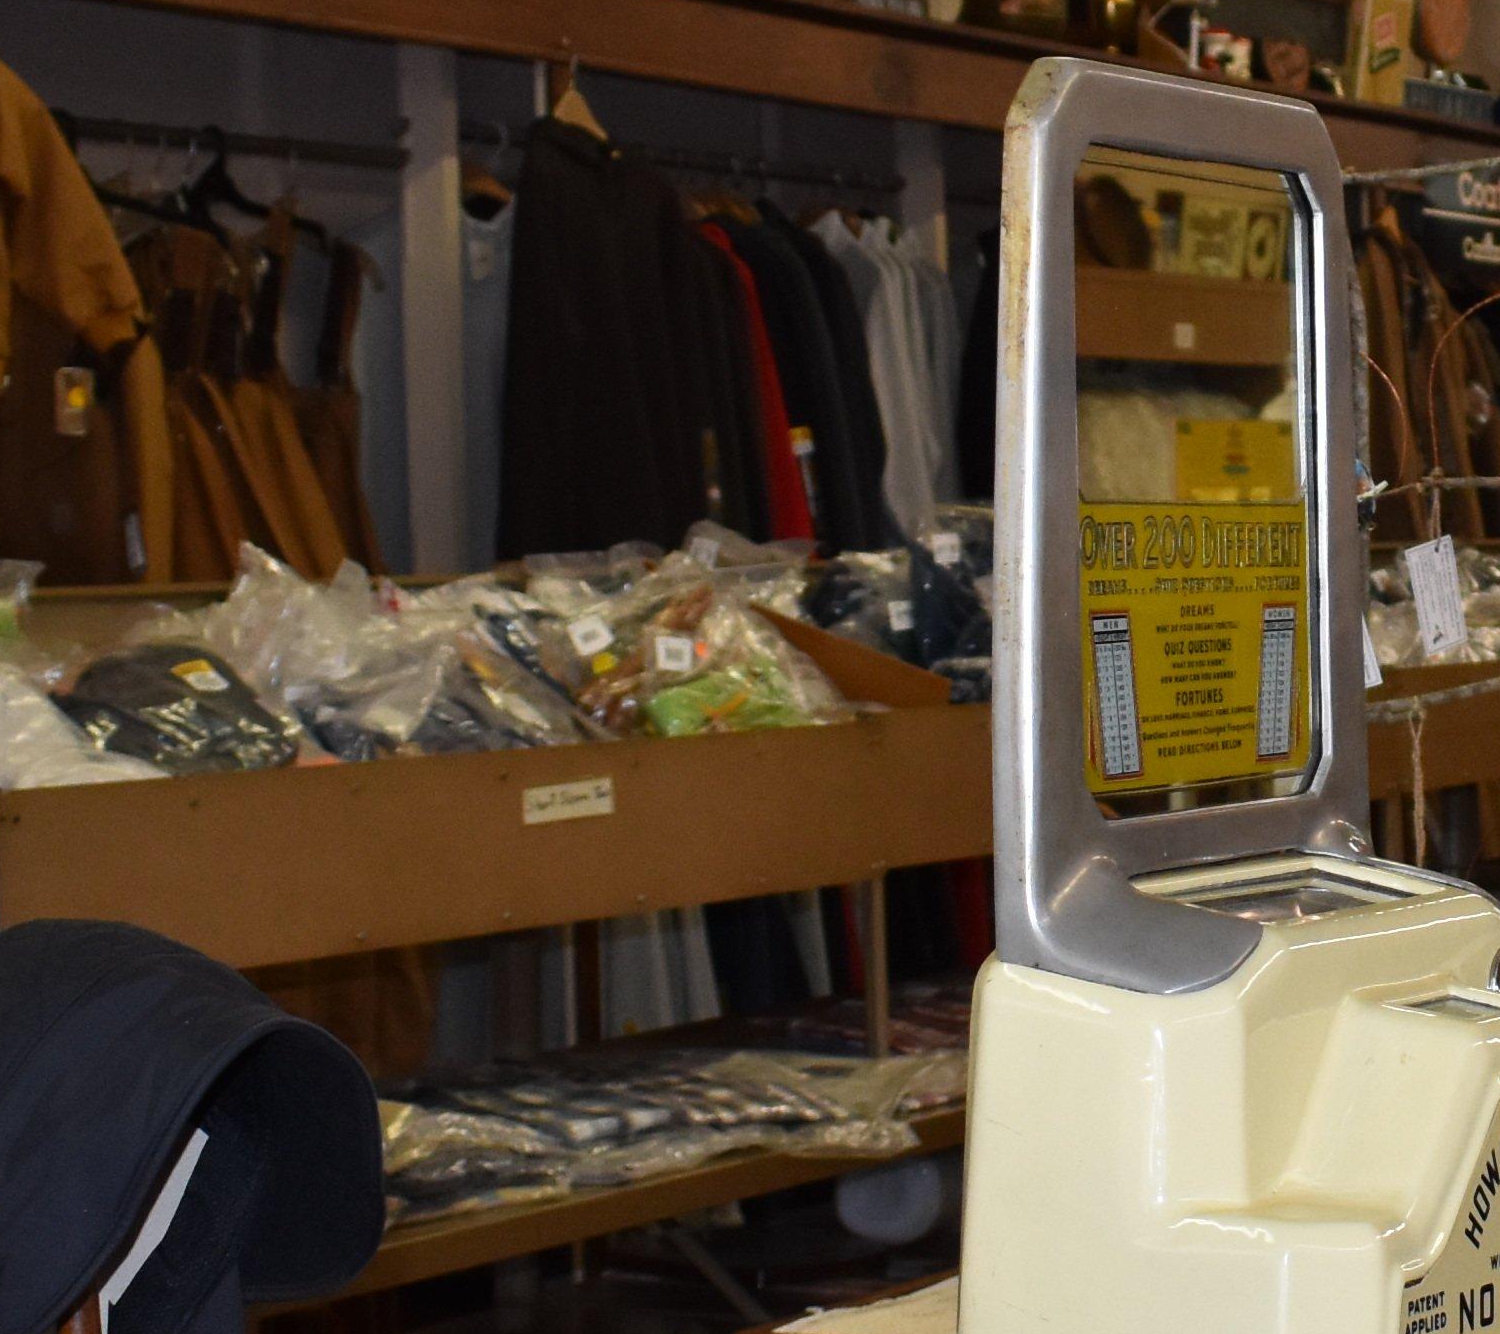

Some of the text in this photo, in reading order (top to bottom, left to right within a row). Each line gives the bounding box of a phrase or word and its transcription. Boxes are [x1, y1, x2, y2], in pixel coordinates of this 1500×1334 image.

[1079, 515, 1302, 570] OVER 200 DIFFERENT
[1180, 604, 1215, 618] DREAMS
[1164, 638, 1232, 656] QUIZ QUESTIONS
[1176, 688, 1224, 707] FORTUNES
[1465, 1150, 1500, 1249] HOW
[1408, 1291, 1445, 1317] PATENT
[1459, 1283, 1494, 1334] NO
